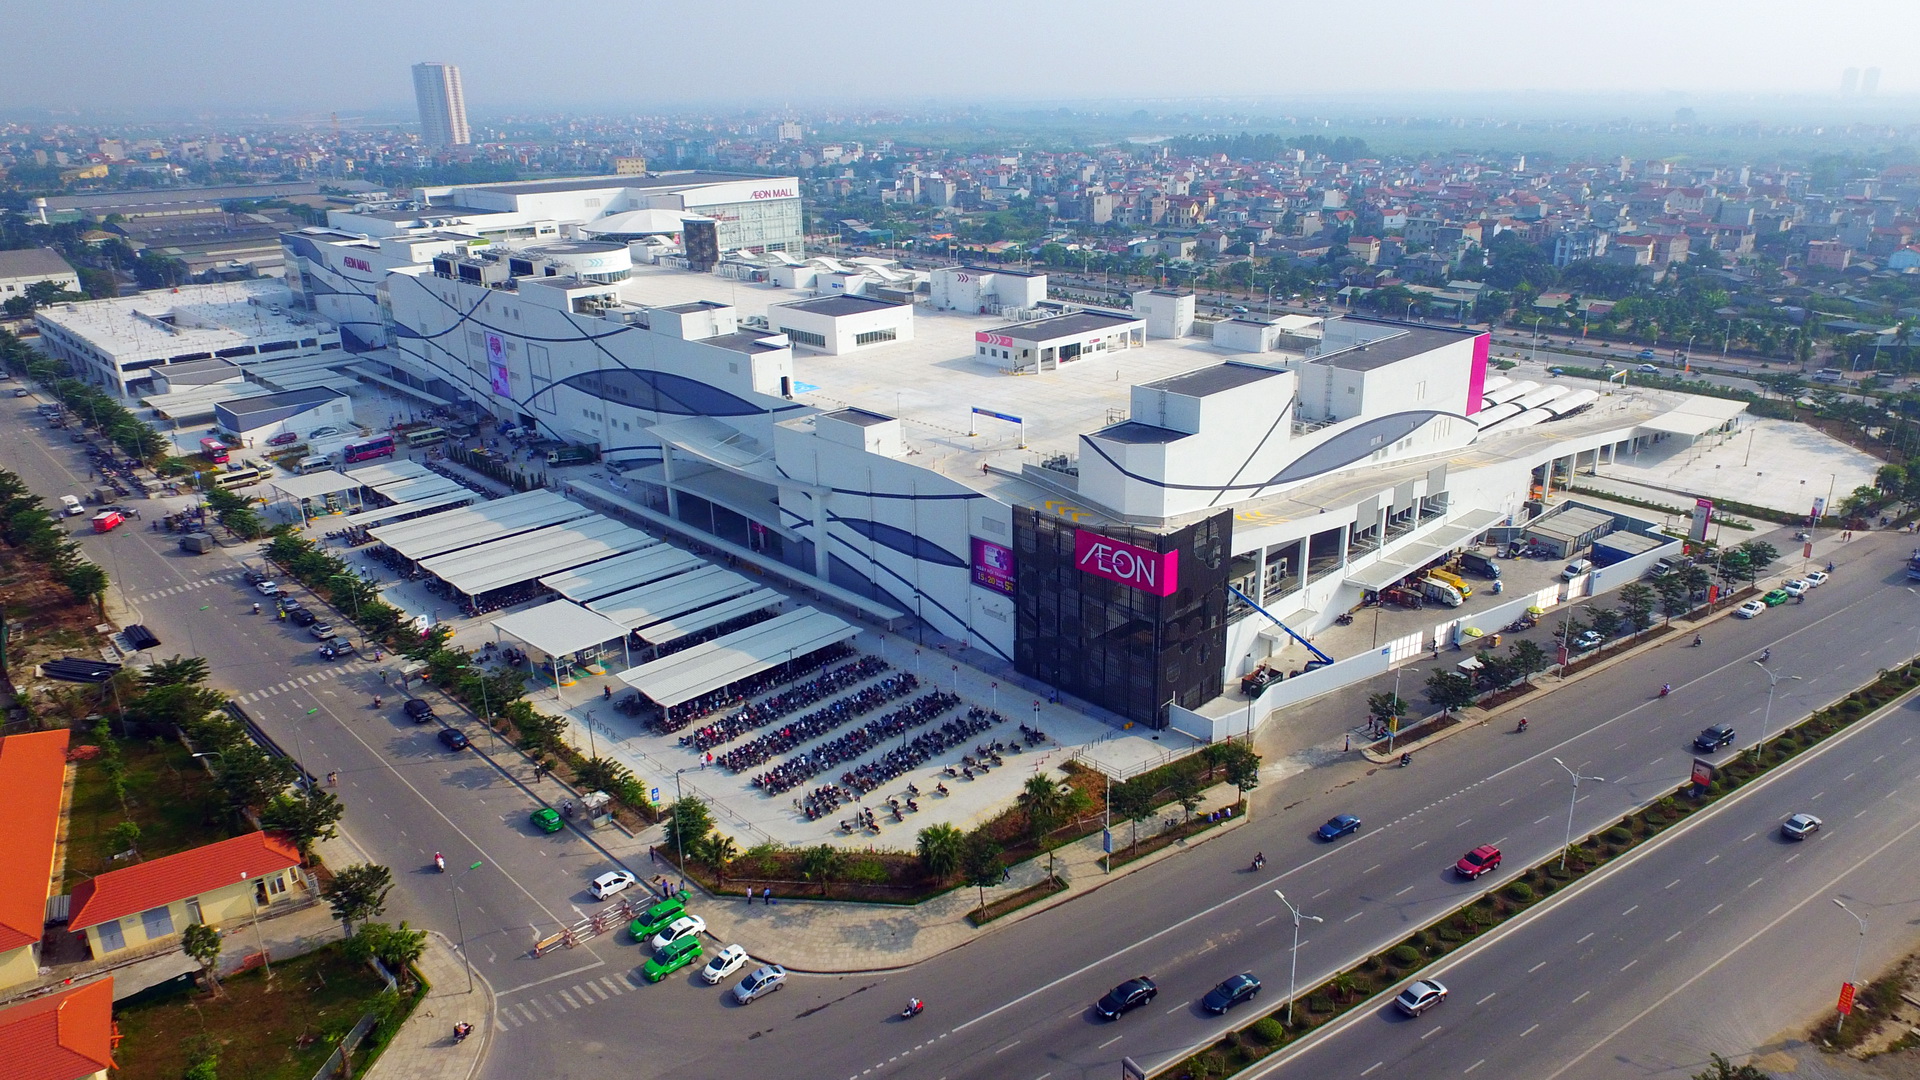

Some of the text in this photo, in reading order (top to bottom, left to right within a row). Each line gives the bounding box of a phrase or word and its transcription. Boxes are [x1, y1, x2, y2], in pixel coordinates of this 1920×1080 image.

[773, 188, 794, 198] MALL
[978, 572, 984, 581] 15
[987, 575, 995, 585] 20
